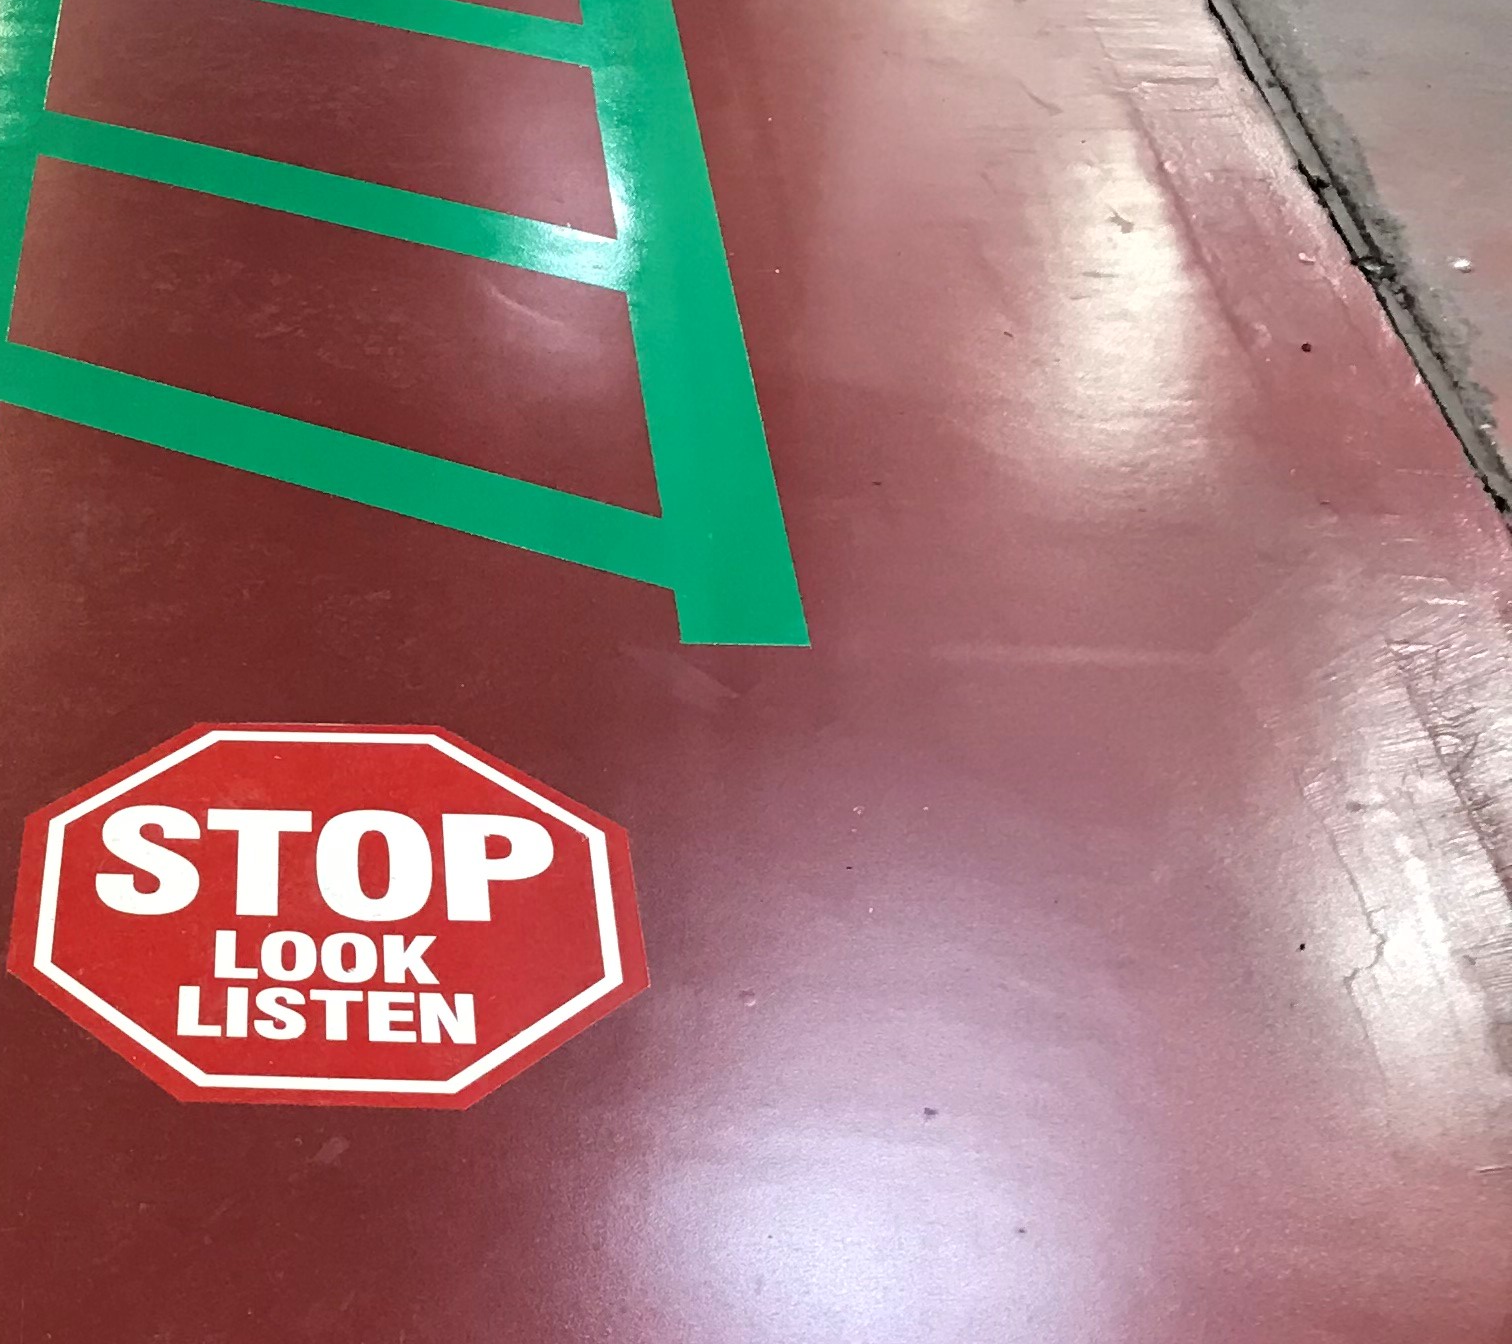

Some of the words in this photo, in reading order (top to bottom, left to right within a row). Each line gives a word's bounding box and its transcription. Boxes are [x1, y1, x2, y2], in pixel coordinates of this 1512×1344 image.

[95, 804, 555, 922] STOP
[214, 930, 440, 985] LOOK
[177, 985, 477, 1045] LISTEN
